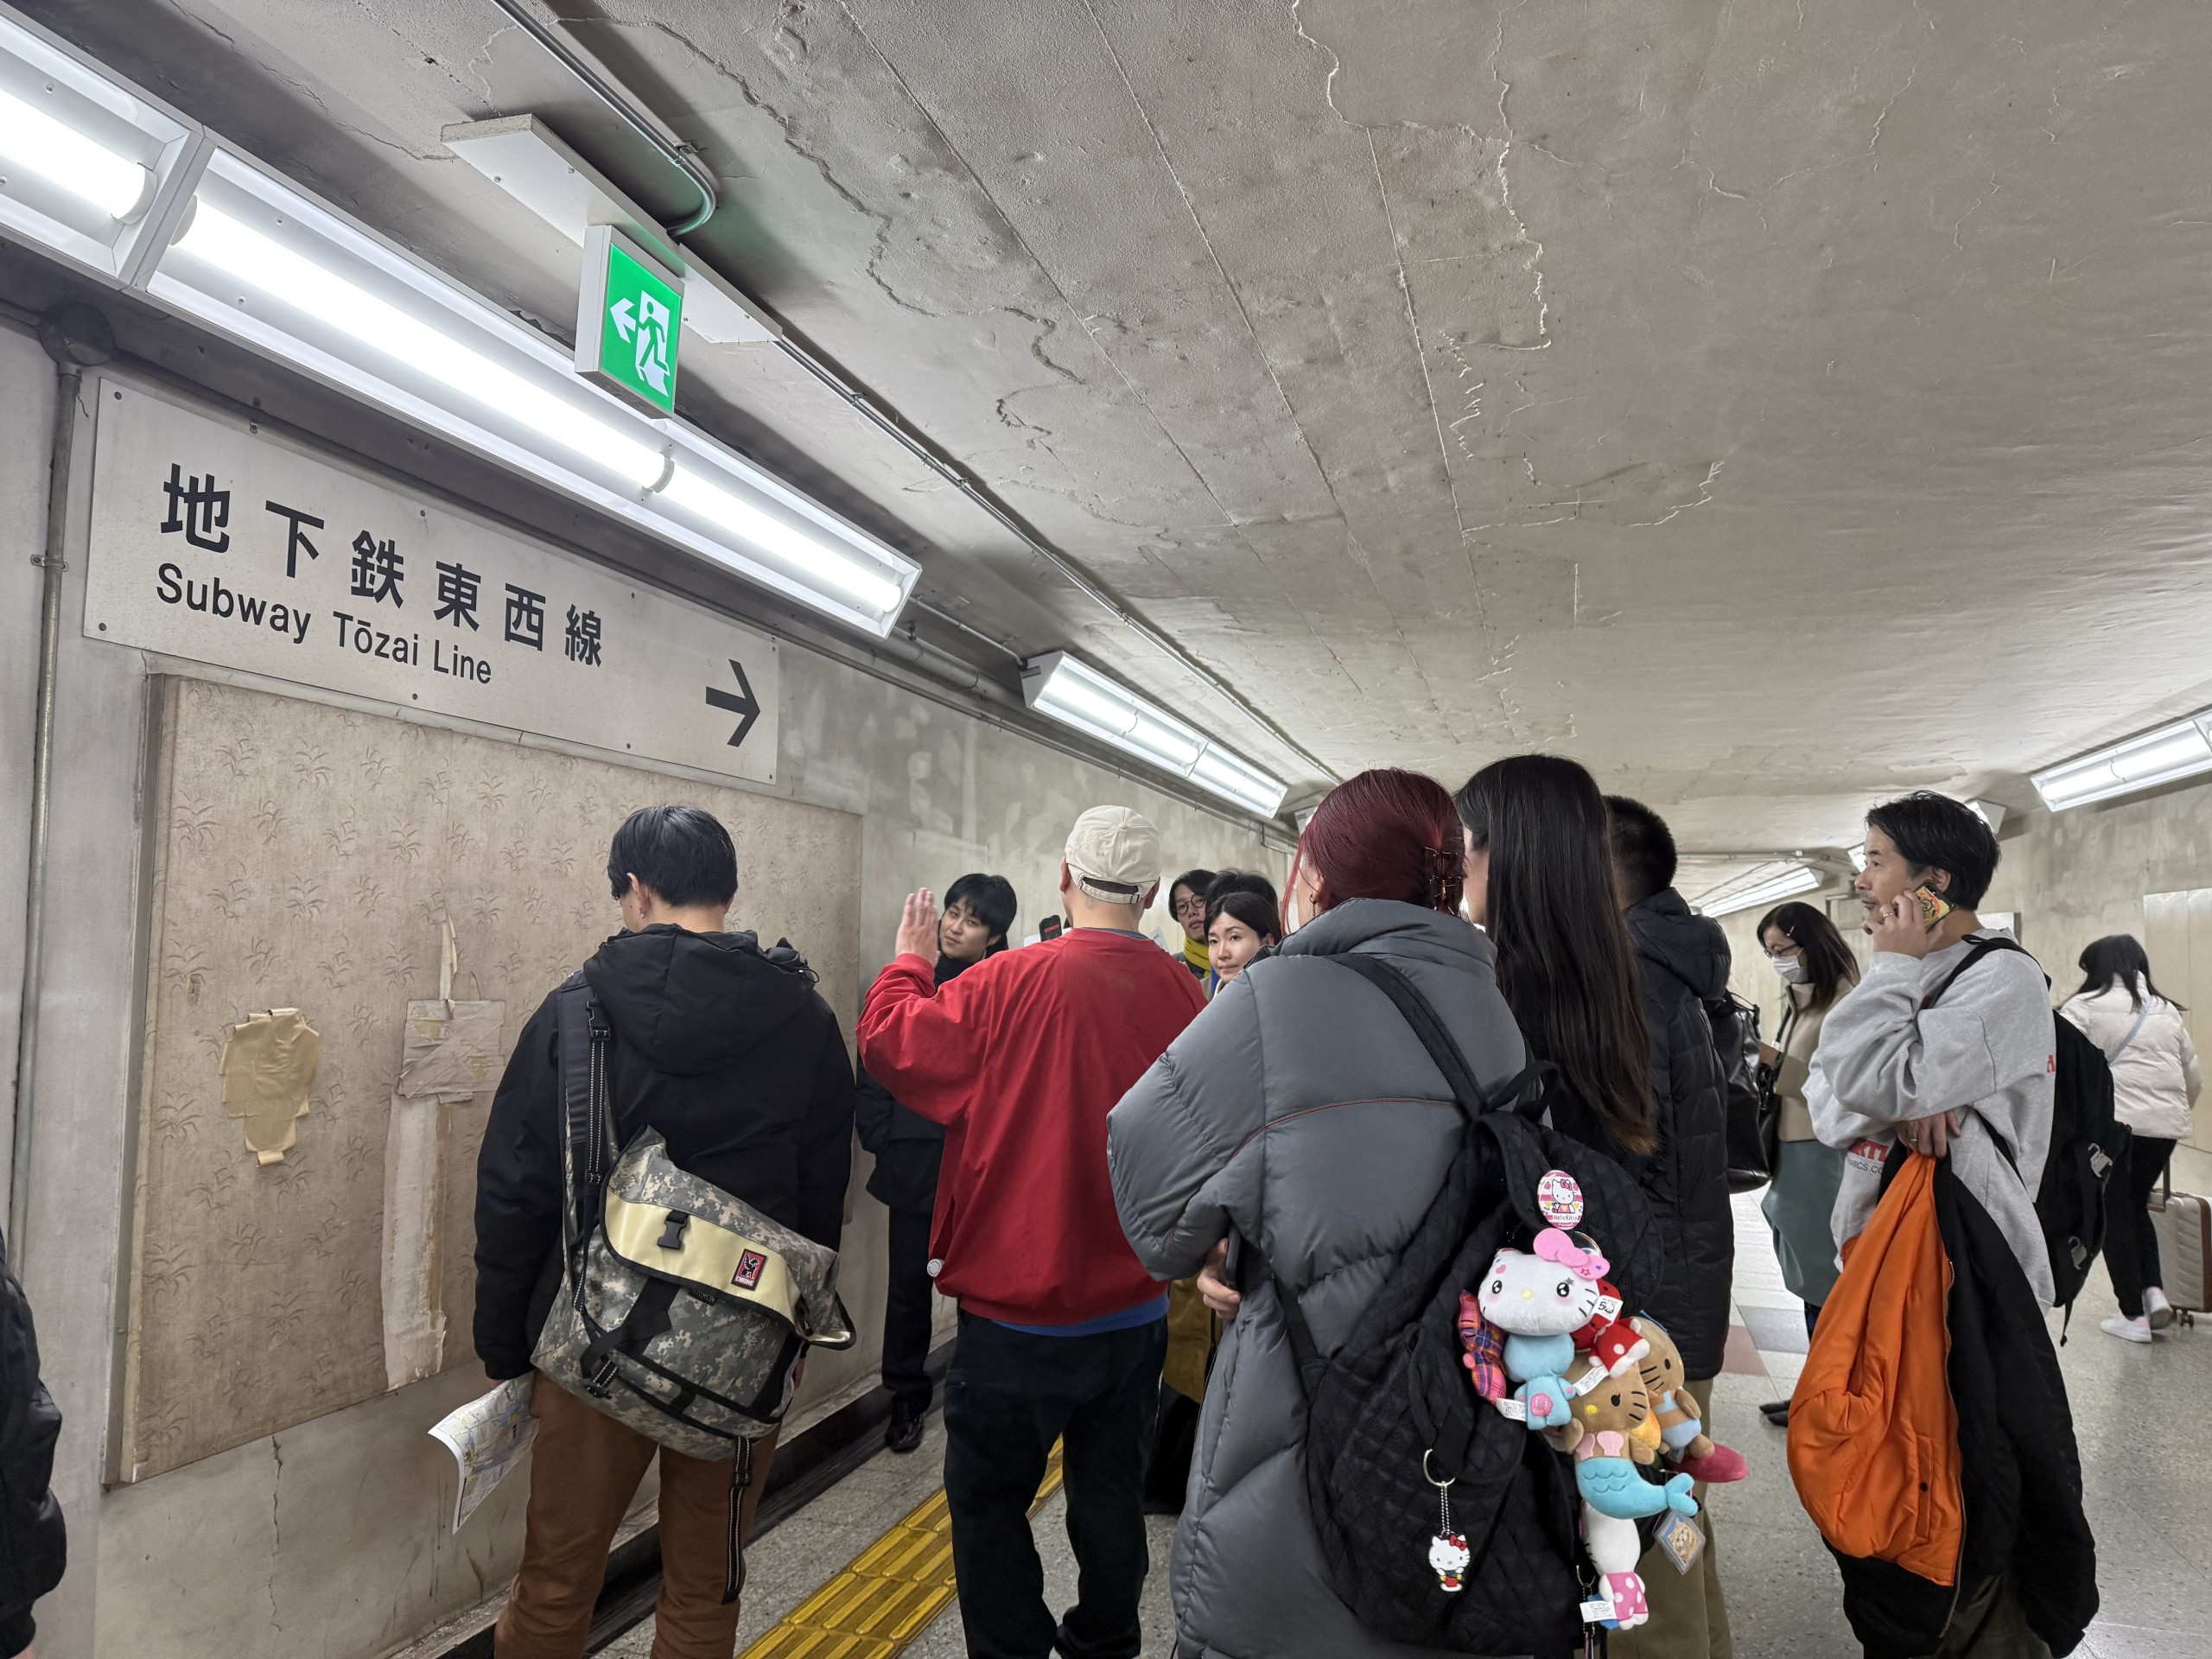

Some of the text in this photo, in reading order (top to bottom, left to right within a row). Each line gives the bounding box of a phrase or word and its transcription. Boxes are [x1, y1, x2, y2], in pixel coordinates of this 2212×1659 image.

[156, 563, 492, 684] Subway Tōzai Line
[160, 462, 603, 668] 地下鉄東西線
[734, 1275, 755, 1287] CHROME
